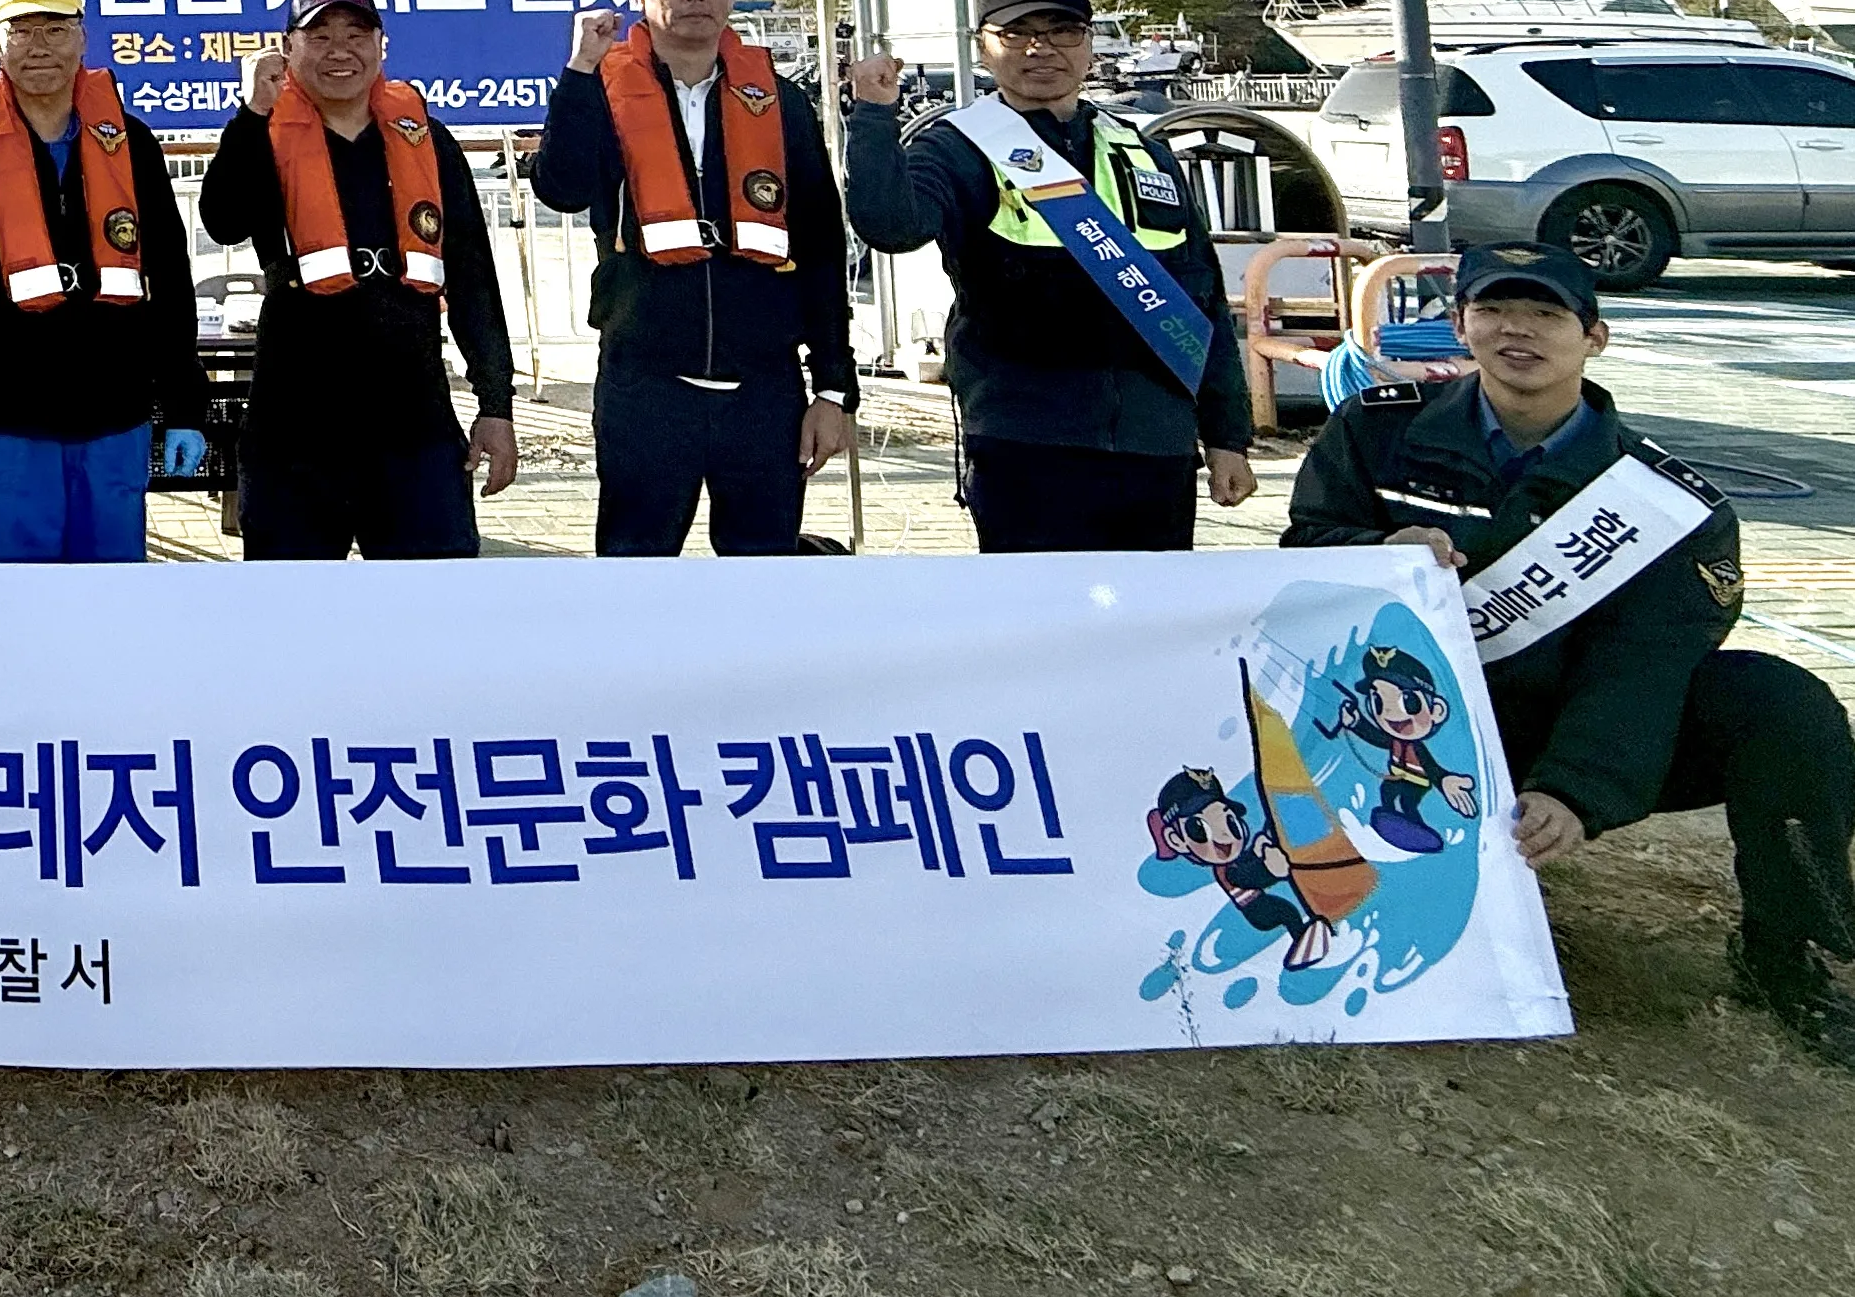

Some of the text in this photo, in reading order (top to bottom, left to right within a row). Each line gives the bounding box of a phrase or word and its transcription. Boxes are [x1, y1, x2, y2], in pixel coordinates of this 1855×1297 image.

[112, 32, 176, 65] 장소
[1141, 184, 1175, 202] POLICE
[1075, 217, 1126, 261] 함께
[1116, 263, 1168, 312] 해요
[1554, 506, 1640, 581] 함께
[231, 733, 703, 884] 안전문화
[716, 731, 1075, 880] 캠페인
